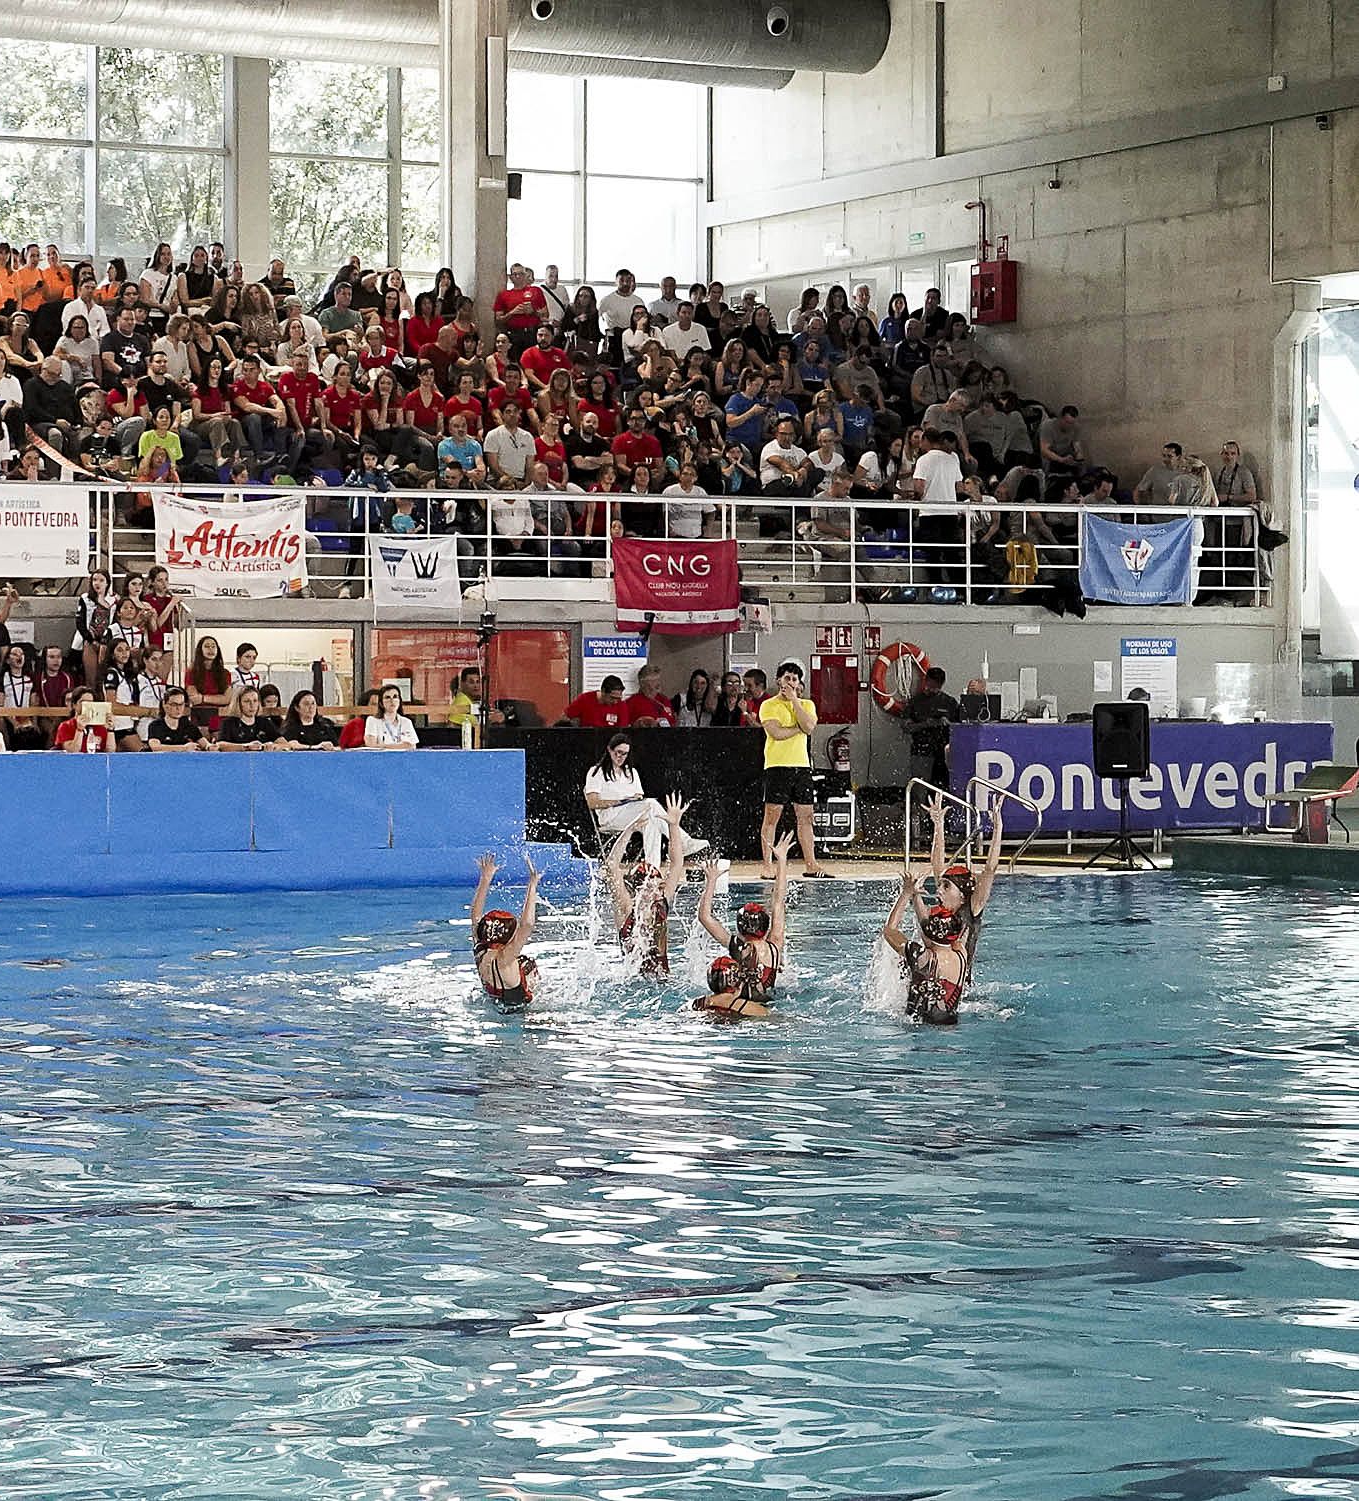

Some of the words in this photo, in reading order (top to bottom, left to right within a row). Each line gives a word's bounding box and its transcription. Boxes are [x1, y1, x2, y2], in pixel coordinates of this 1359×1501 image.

[5, 511, 79, 527] PONTEVEDRA
[183, 521, 300, 564] Atlantis
[643, 554, 711, 576] CNG
[588, 640, 617, 648] NORMAS
[618, 640, 627, 648] DE
[628, 640, 643, 648] USO
[1125, 640, 1151, 648] NORMAS
[1152, 640, 1160, 648] DE
[1160, 640, 1173, 648] USO
[593, 648, 602, 656] DE
[603, 648, 616, 656] LOS
[616, 648, 637, 656] VASOS
[1130, 647, 1138, 655] DE
[1138, 647, 1150, 655] LOS
[1149, 647, 1169, 655] VASOS
